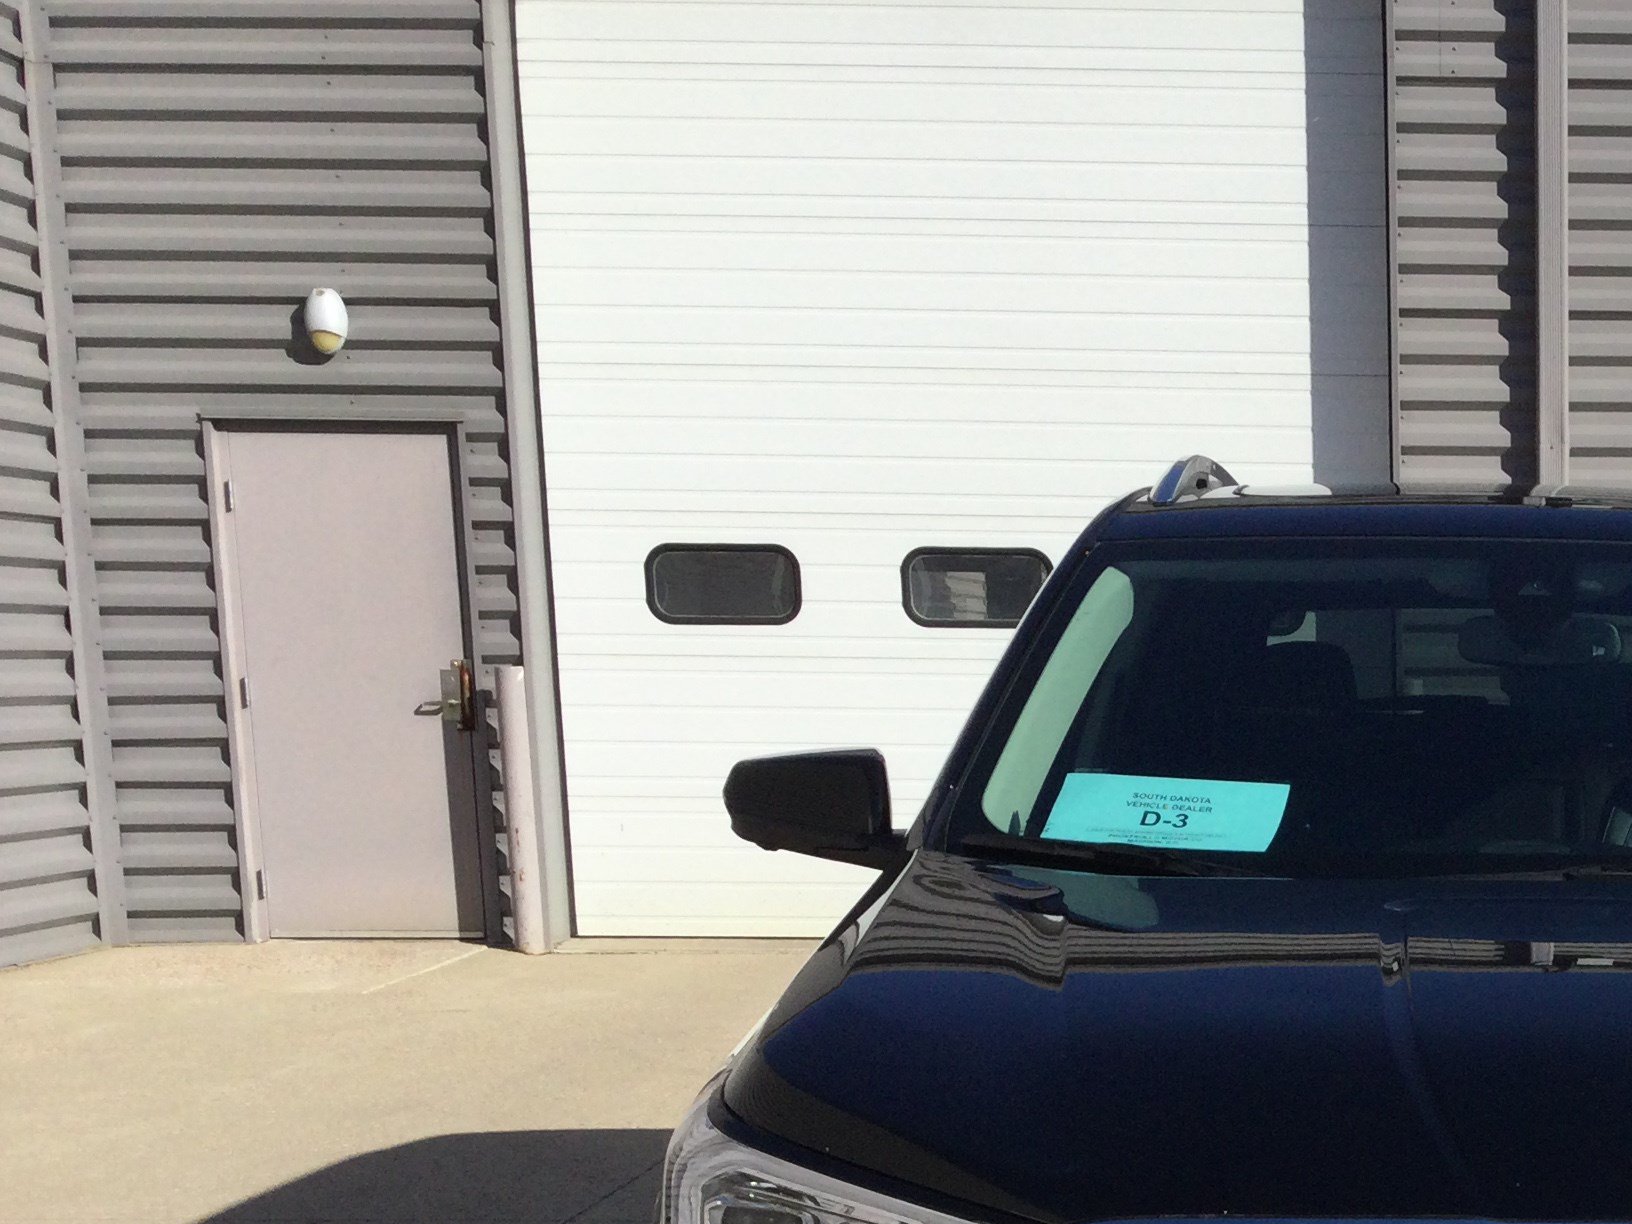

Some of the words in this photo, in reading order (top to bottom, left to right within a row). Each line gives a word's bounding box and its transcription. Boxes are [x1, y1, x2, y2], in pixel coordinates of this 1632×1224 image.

[1132, 792, 1167, 801] SOUTH
[1169, 795, 1212, 804] DAKOTA
[1126, 800, 1168, 810] VEHICLE
[1171, 804, 1213, 813] DEALER
[1139, 810, 1189, 828] D-3
